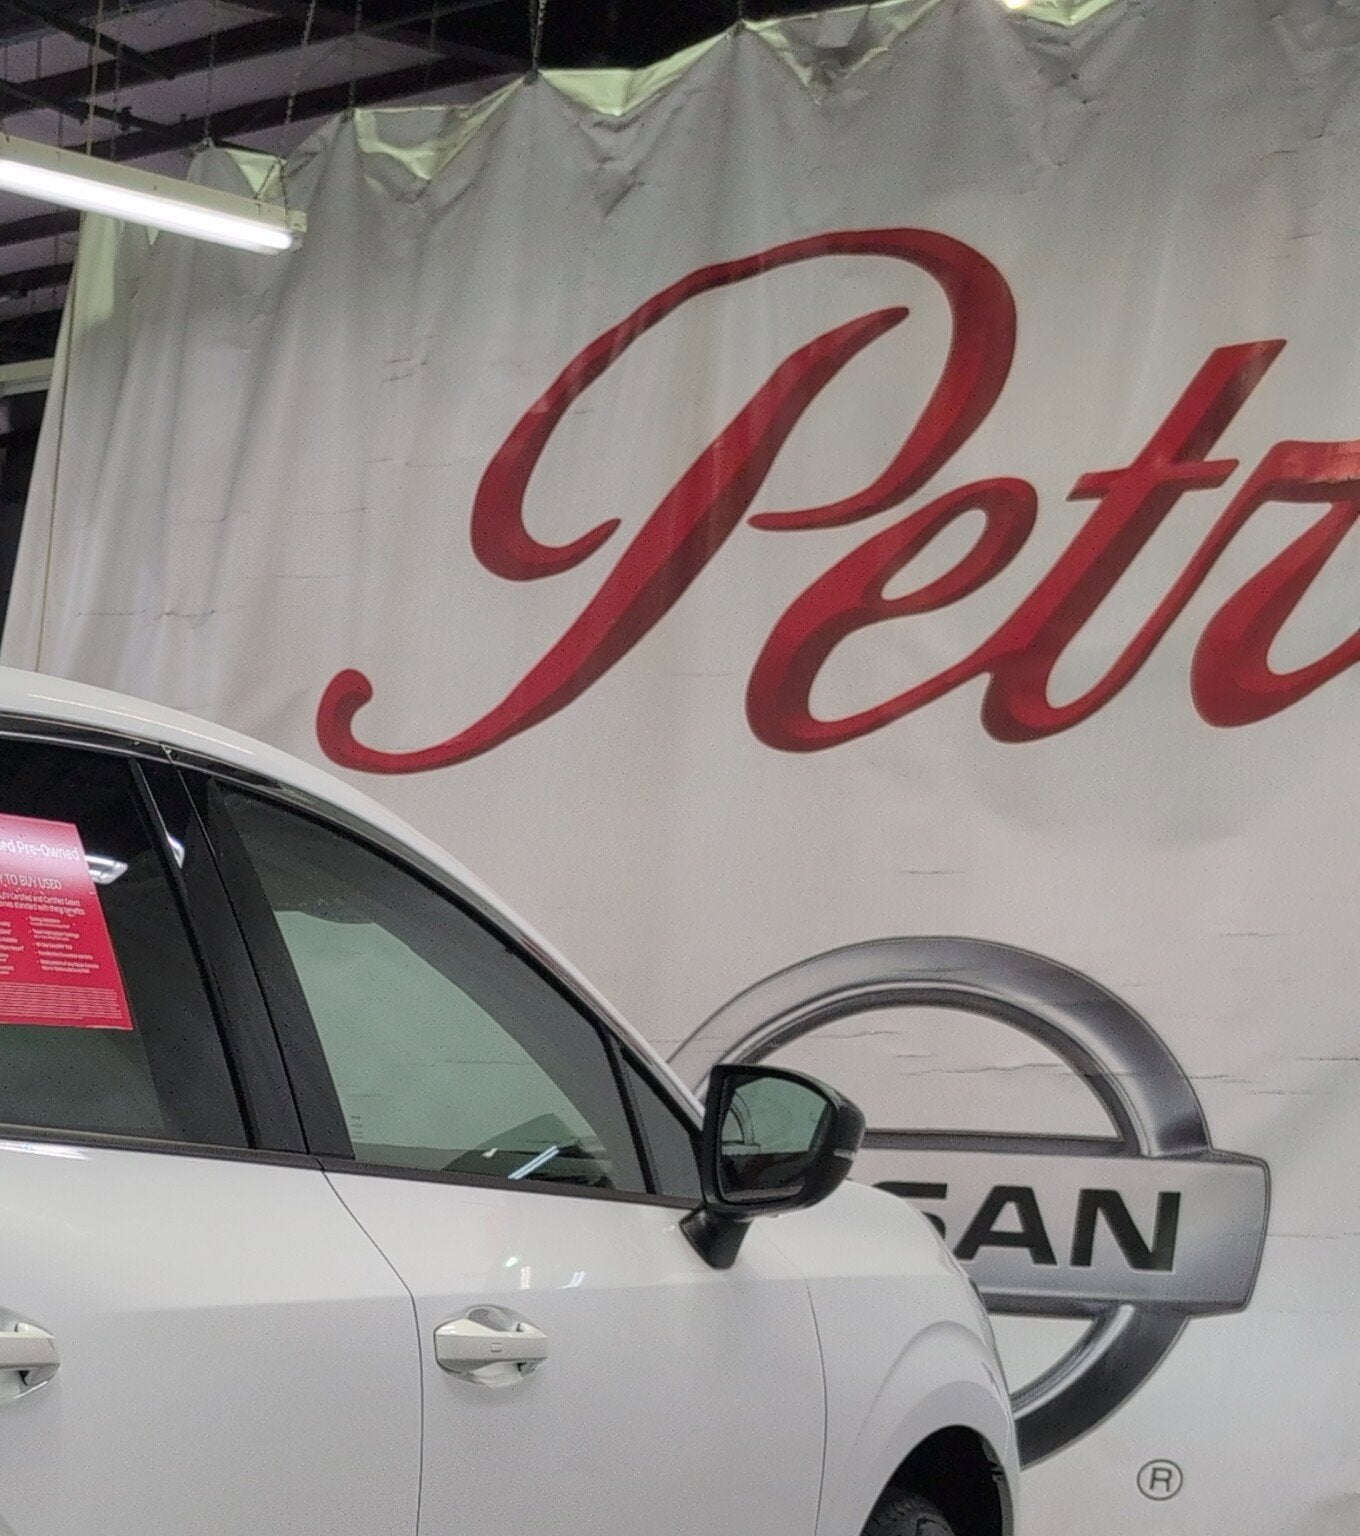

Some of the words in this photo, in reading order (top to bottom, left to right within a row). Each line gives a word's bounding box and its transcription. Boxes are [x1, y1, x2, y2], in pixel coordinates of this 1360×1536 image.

[316, 226, 1360, 776] Petr
[16, 841, 80, 861] Pre-Owned
[5, 874, 18, 885] TO
[18, 876, 38, 888] BUY
[38, 878, 63, 890] USED
